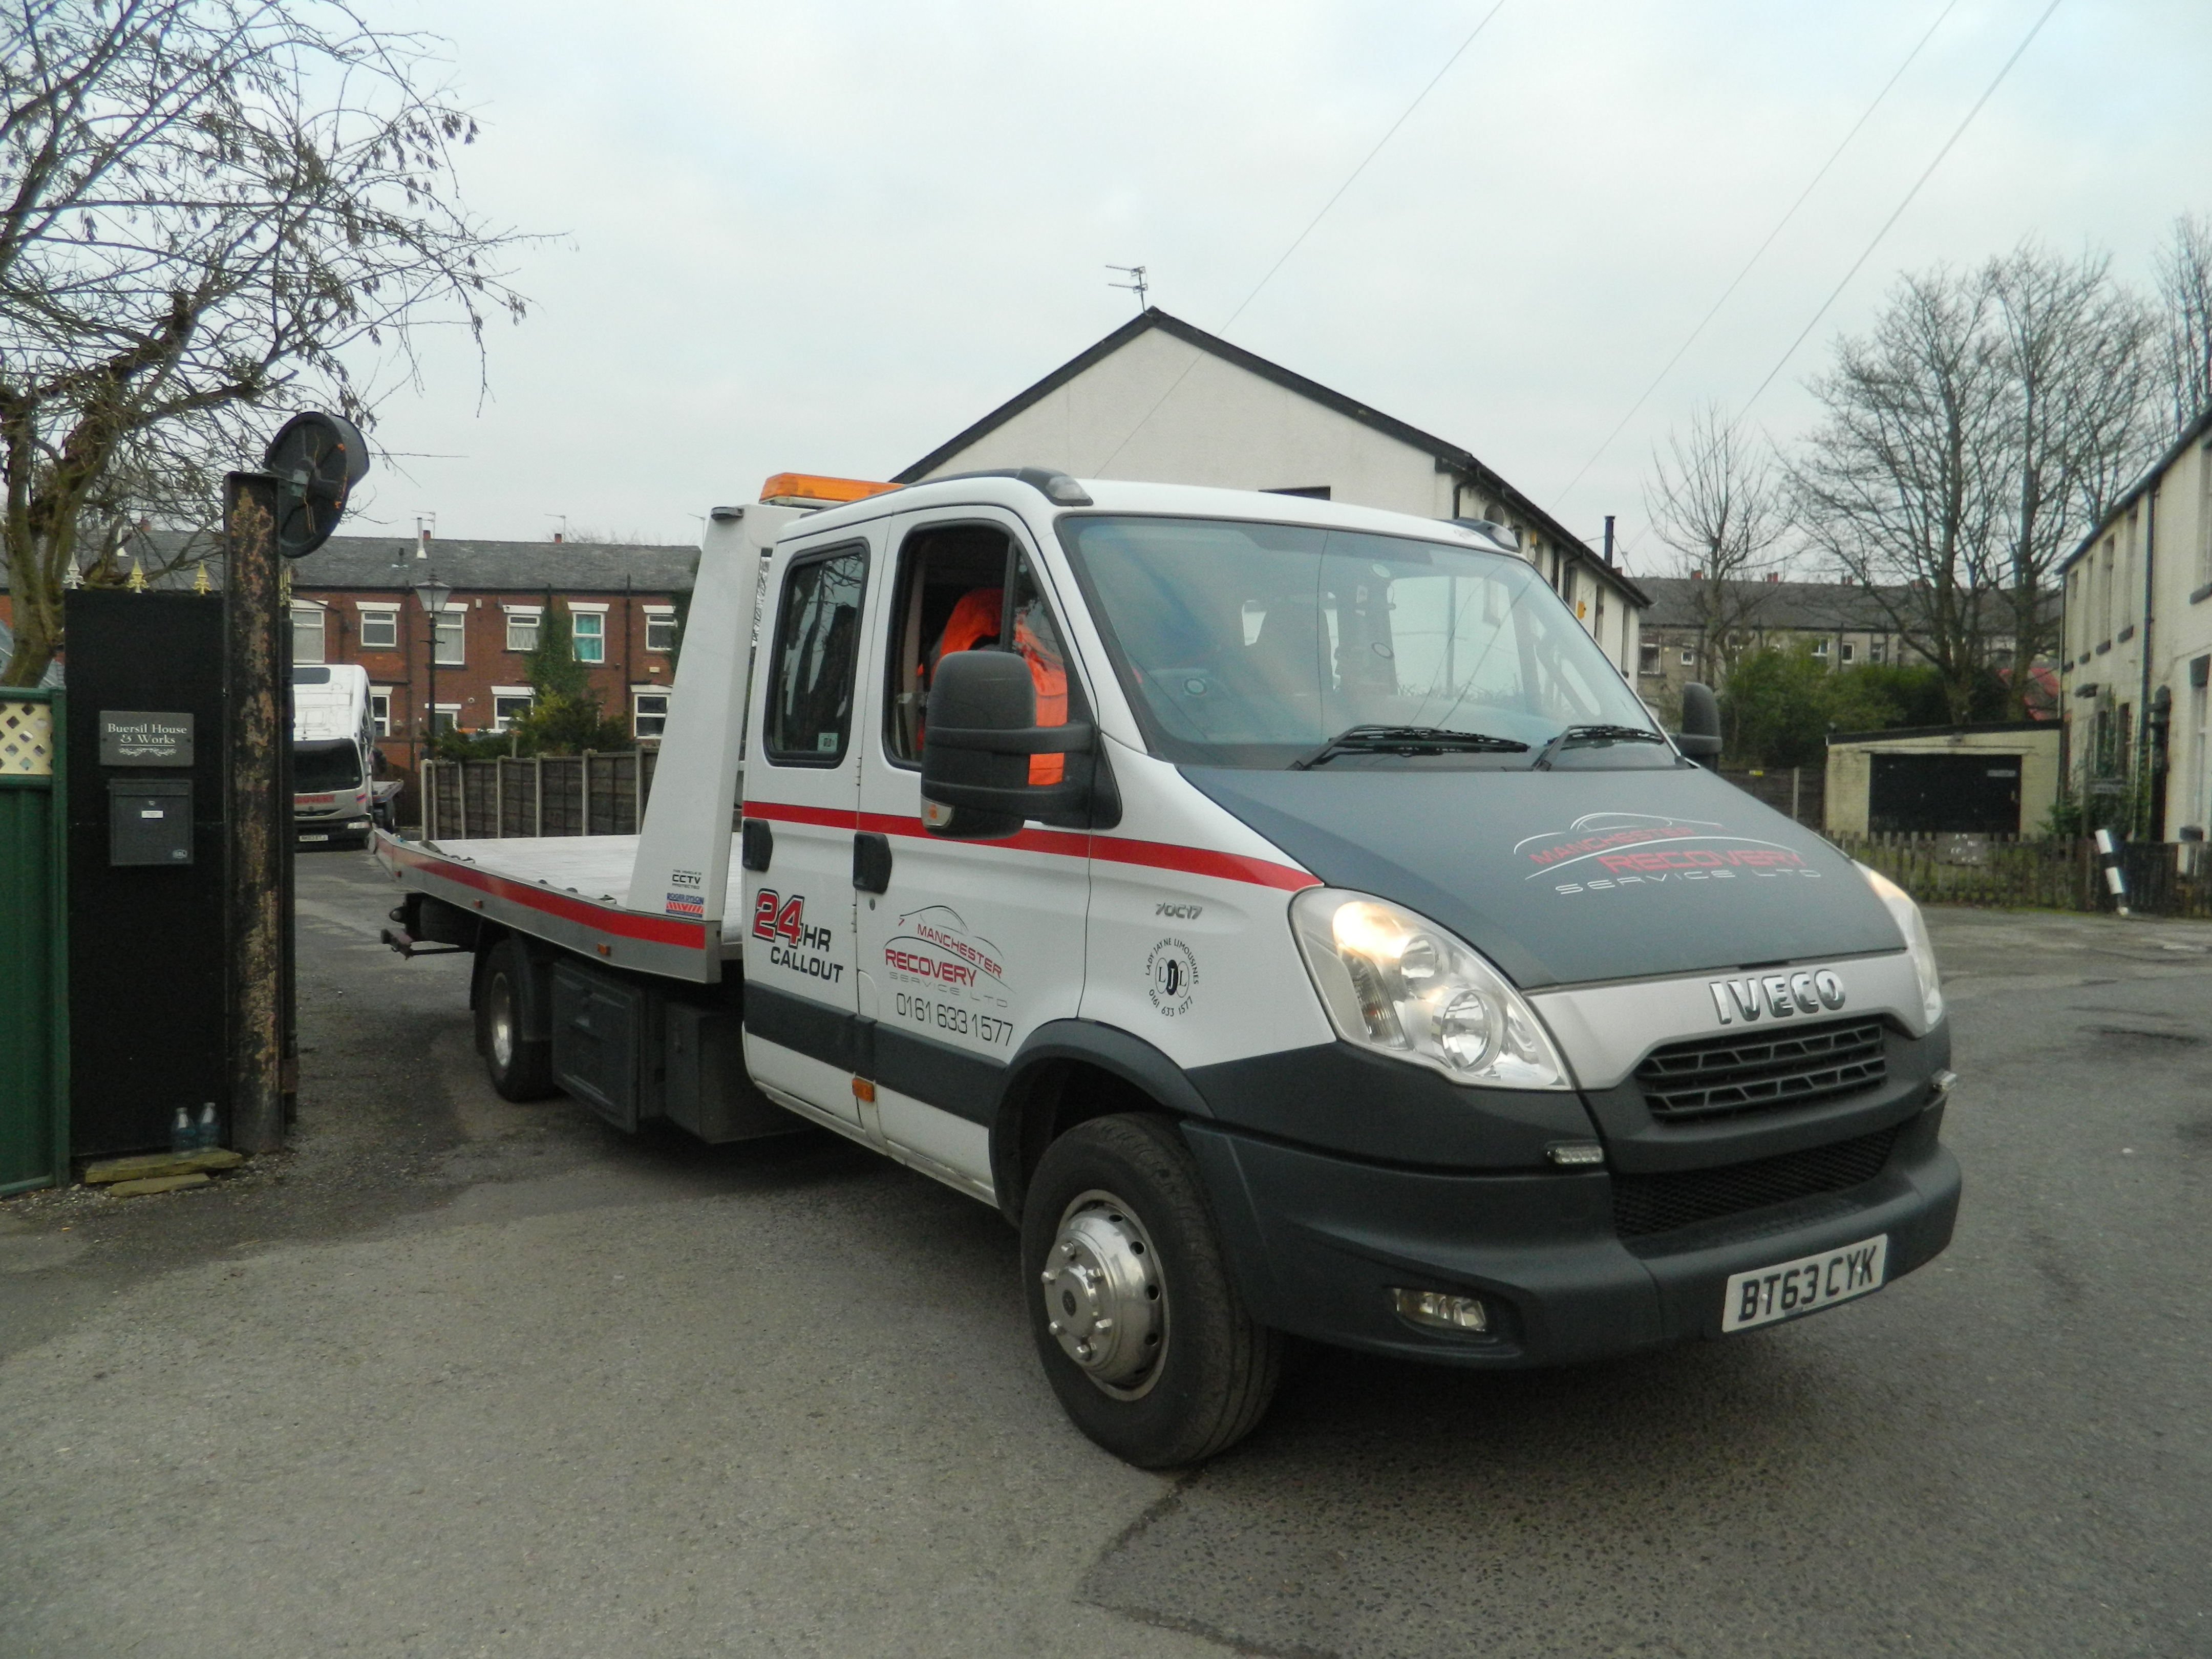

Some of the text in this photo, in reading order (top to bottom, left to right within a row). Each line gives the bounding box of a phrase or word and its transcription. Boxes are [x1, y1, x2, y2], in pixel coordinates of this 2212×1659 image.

[108, 723, 187, 734] Buersil House
[120, 734, 176, 744] & Works
[1529, 827, 1698, 865] MANCHESTER
[1596, 850, 1806, 874] RECOVERY
[672, 874, 701, 884] CCTV
[1555, 868, 1821, 895] SERVICE LTD
[771, 946, 844, 983] CALLOUT
[885, 949, 977, 987] RECOVERY
[917, 923, 1002, 979] MANCHESTER
[1145, 938, 1199, 984] LADY JAYNE LIMOUSINES
[889, 971, 1007, 1008] SERVICE LTD
[1148, 989, 1193, 1017] 0161 633 1577
[1709, 969, 1845, 1025] IVECO
[897, 992, 1013, 1047] 0161 633 1577
[1738, 1245, 1877, 1322] BT63 CYK
